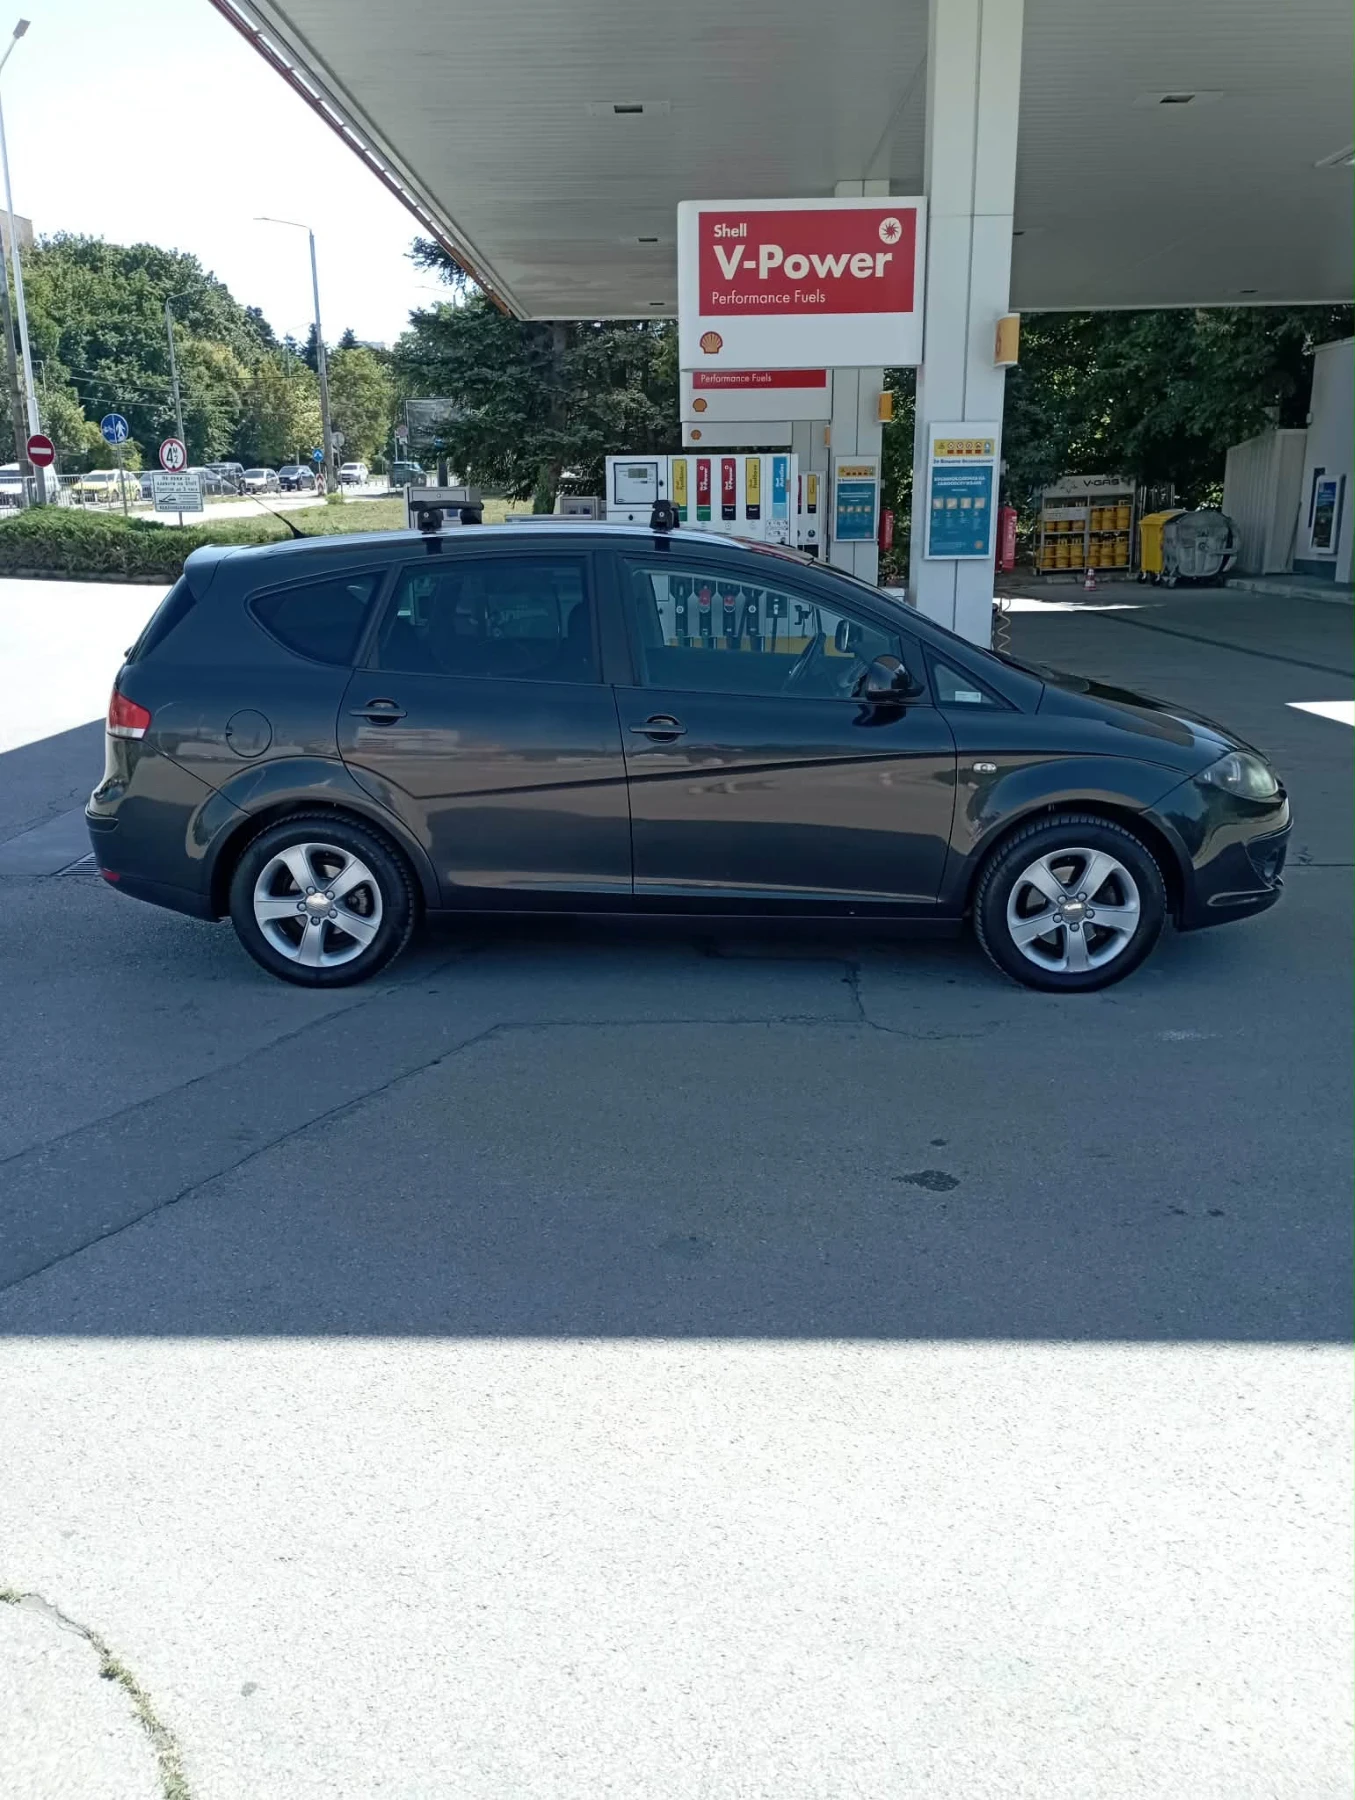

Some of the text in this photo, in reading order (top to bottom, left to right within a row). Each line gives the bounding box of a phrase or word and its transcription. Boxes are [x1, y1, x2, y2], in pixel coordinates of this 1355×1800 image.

[713, 223, 747, 238] Shell
[713, 244, 893, 280] V-Power
[712, 289, 826, 305] Performance Fuels
[701, 372, 772, 383] Performance Fuels
[1083, 478, 1120, 487] V-GAS
